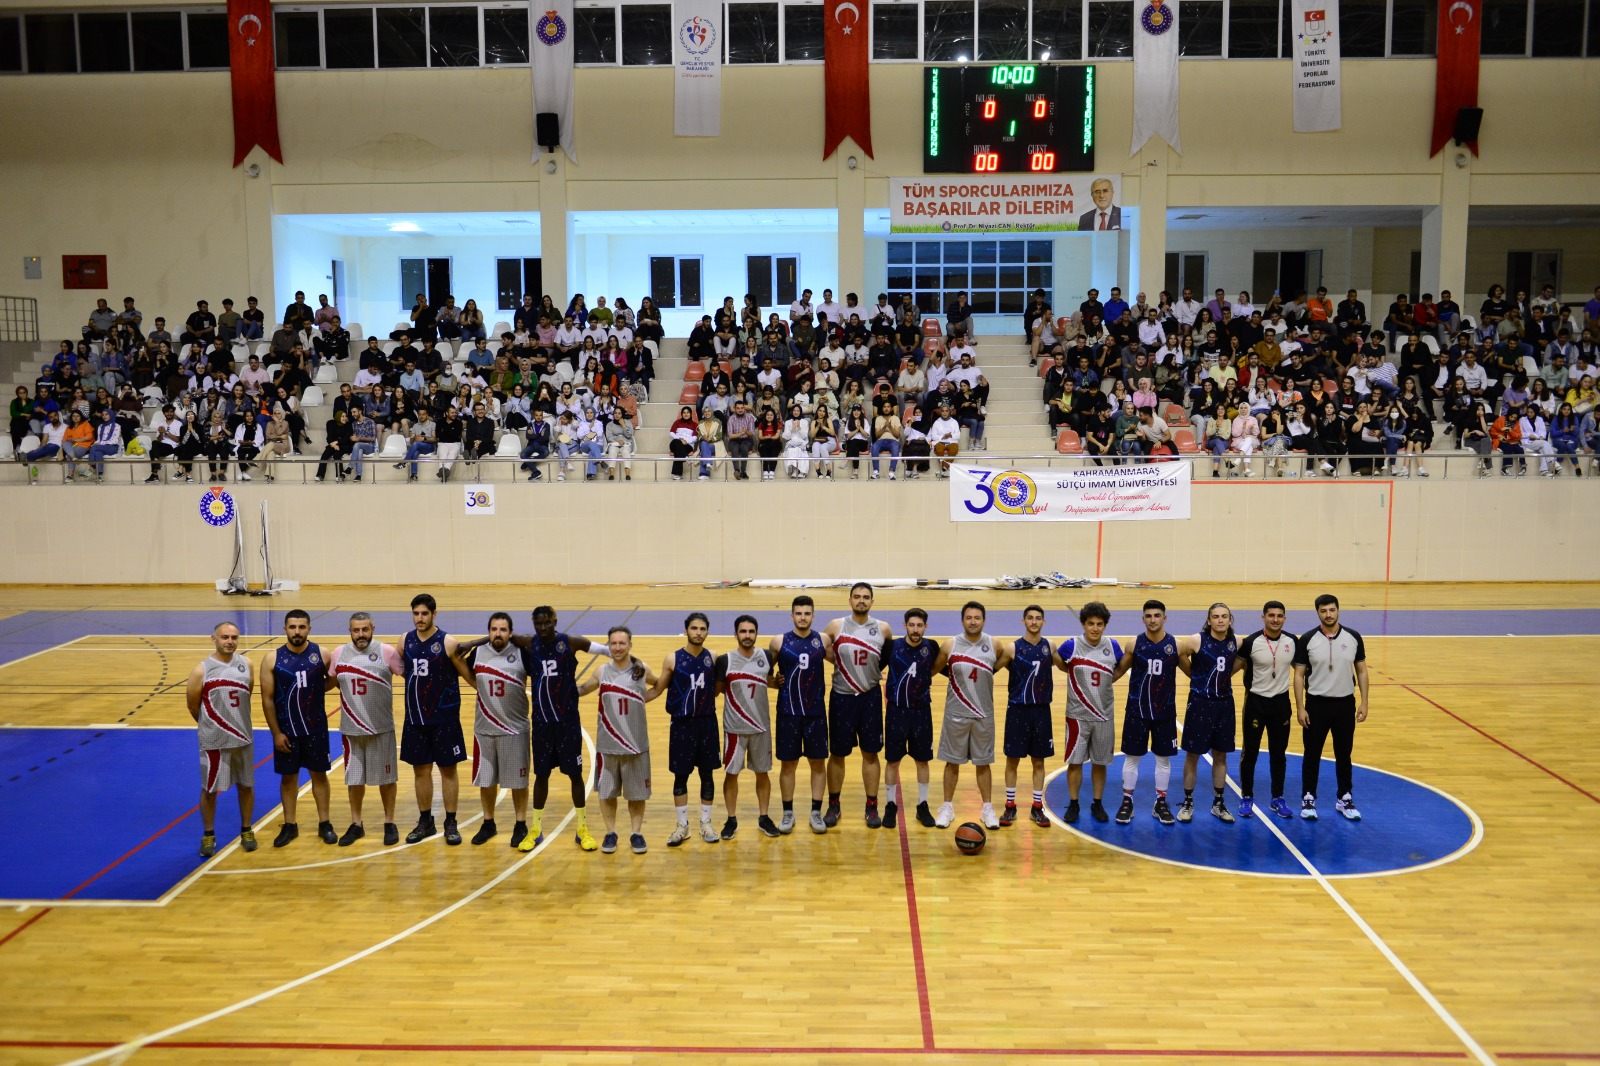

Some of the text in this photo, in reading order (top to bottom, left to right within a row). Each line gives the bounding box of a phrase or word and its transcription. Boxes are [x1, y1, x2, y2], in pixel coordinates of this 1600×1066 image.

[1301, 59, 1330, 67] ÜNİVERSİTE
[992, 66, 1035, 84] 10:00
[1303, 70, 1328, 78] SPORLARI
[1298, 80, 1336, 88] FEDERASYONU
[984, 102, 996, 118] 0
[1034, 100, 1046, 118] 0
[1010, 120, 1016, 136] 1
[974, 144, 1048, 155] HOME GUEST
[976, 153, 1054, 171] 00 00
[902, 183, 1074, 198] TÜM SPORCULARIMIZA
[904, 200, 1074, 218] BAŞARILAR DİLERİM
[1073, 467, 1160, 478] KAHRAMANMARAŞ
[1056, 477, 1177, 490] SÜTÇÜ İMAM ÜNİVERSİTESİ
[1080, 492, 1107, 501] Sürekli
[1064, 504, 1100, 514] Değişimin
[1111, 504, 1144, 513] Geleceğin
[1145, 503, 1172, 511] Adresi
[798, 652, 809, 670] 9
[853, 650, 868, 666] 12
[1216, 656, 1225, 672] 8
[413, 658, 429, 676] 13
[542, 659, 558, 676] 12
[908, 662, 917, 678] 4
[1032, 660, 1041, 676] 7
[1147, 658, 1162, 676] 10
[296, 671, 307, 688] 11
[690, 673, 705, 689] 14
[968, 668, 978, 683] 4
[1091, 672, 1100, 687] 9
[351, 678, 367, 696] 15
[489, 680, 505, 697] 13
[747, 683, 756, 699] 7
[228, 690, 240, 708] 5
[618, 698, 628, 715] 11
[453, 745, 460, 756] 13
[385, 764, 391, 774] 11
[519, 768, 526, 778] 13
